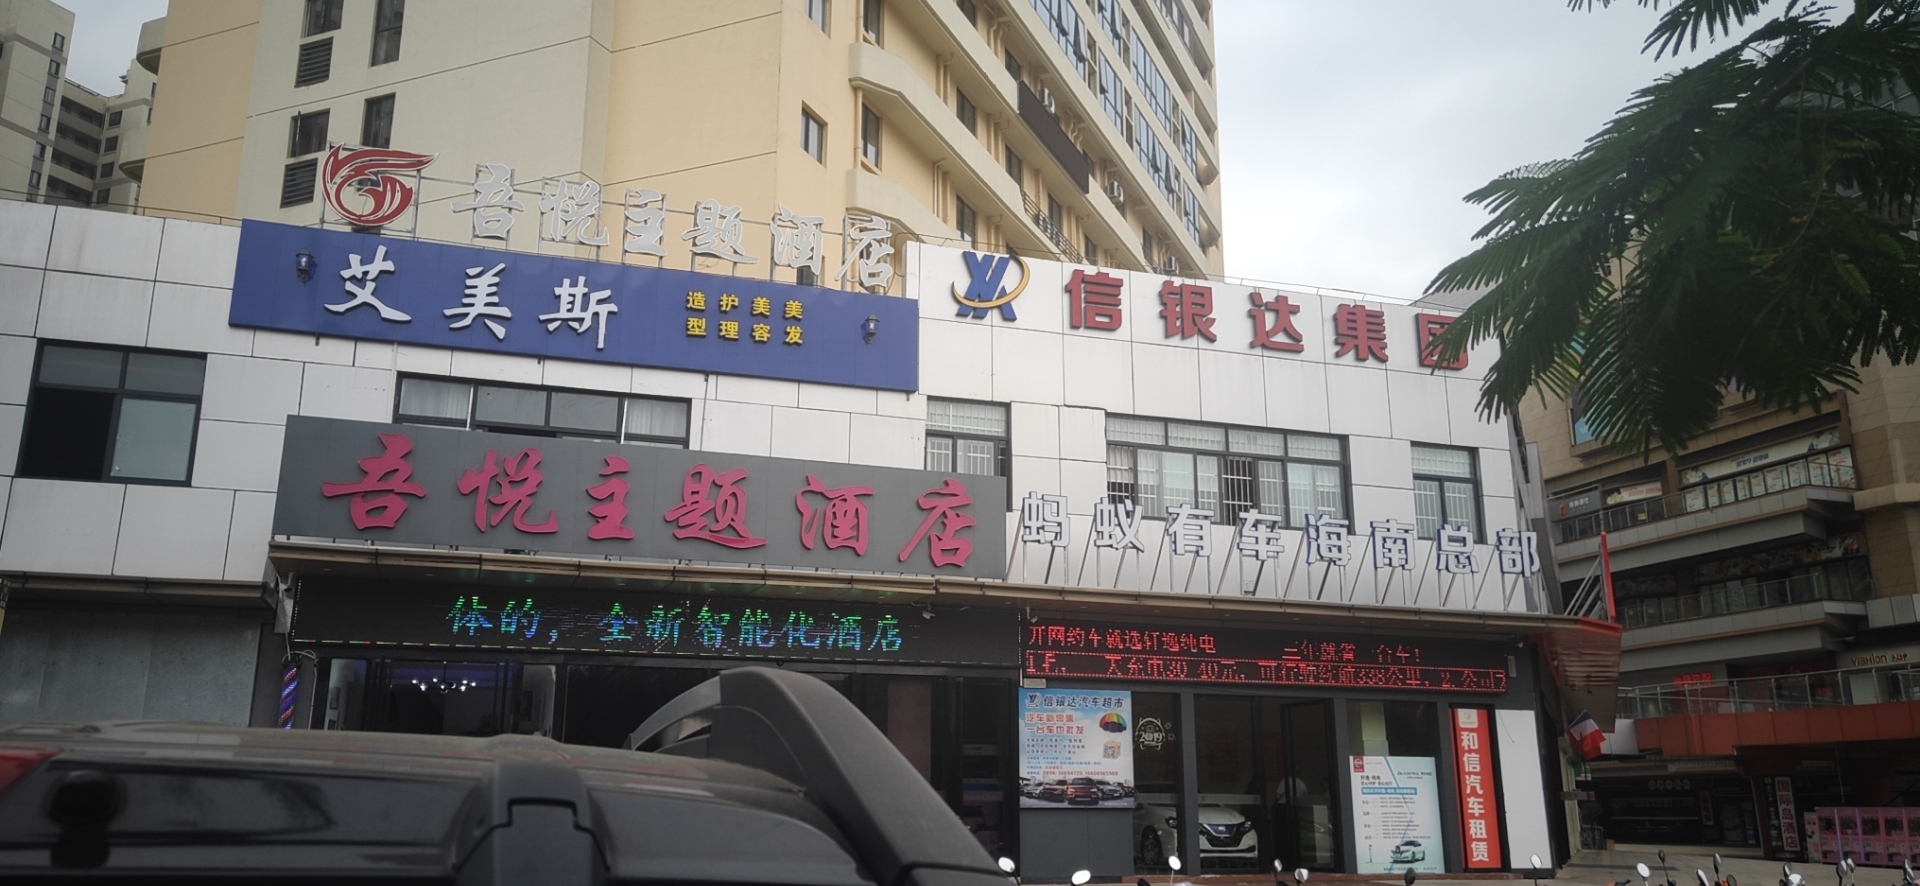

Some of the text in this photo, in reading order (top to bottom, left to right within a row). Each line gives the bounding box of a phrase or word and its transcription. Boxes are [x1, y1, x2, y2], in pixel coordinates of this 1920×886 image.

[450, 162, 896, 290] 吾悦主题酒店
[323, 244, 618, 350] 艾美斯
[1064, 267, 1470, 370] 信银达集团
[321, 432, 976, 568] 吾悦主题酒店
[1021, 491, 1540, 577] 蚂蚁有车海南总部
[1026, 725, 1085, 735] 一台车也批发
[1043, 695, 1124, 709] 信银达汽车超市
[1460, 731, 1489, 862] 和信汽车租赁
[1776, 780, 1798, 849] 国际岛酒店
